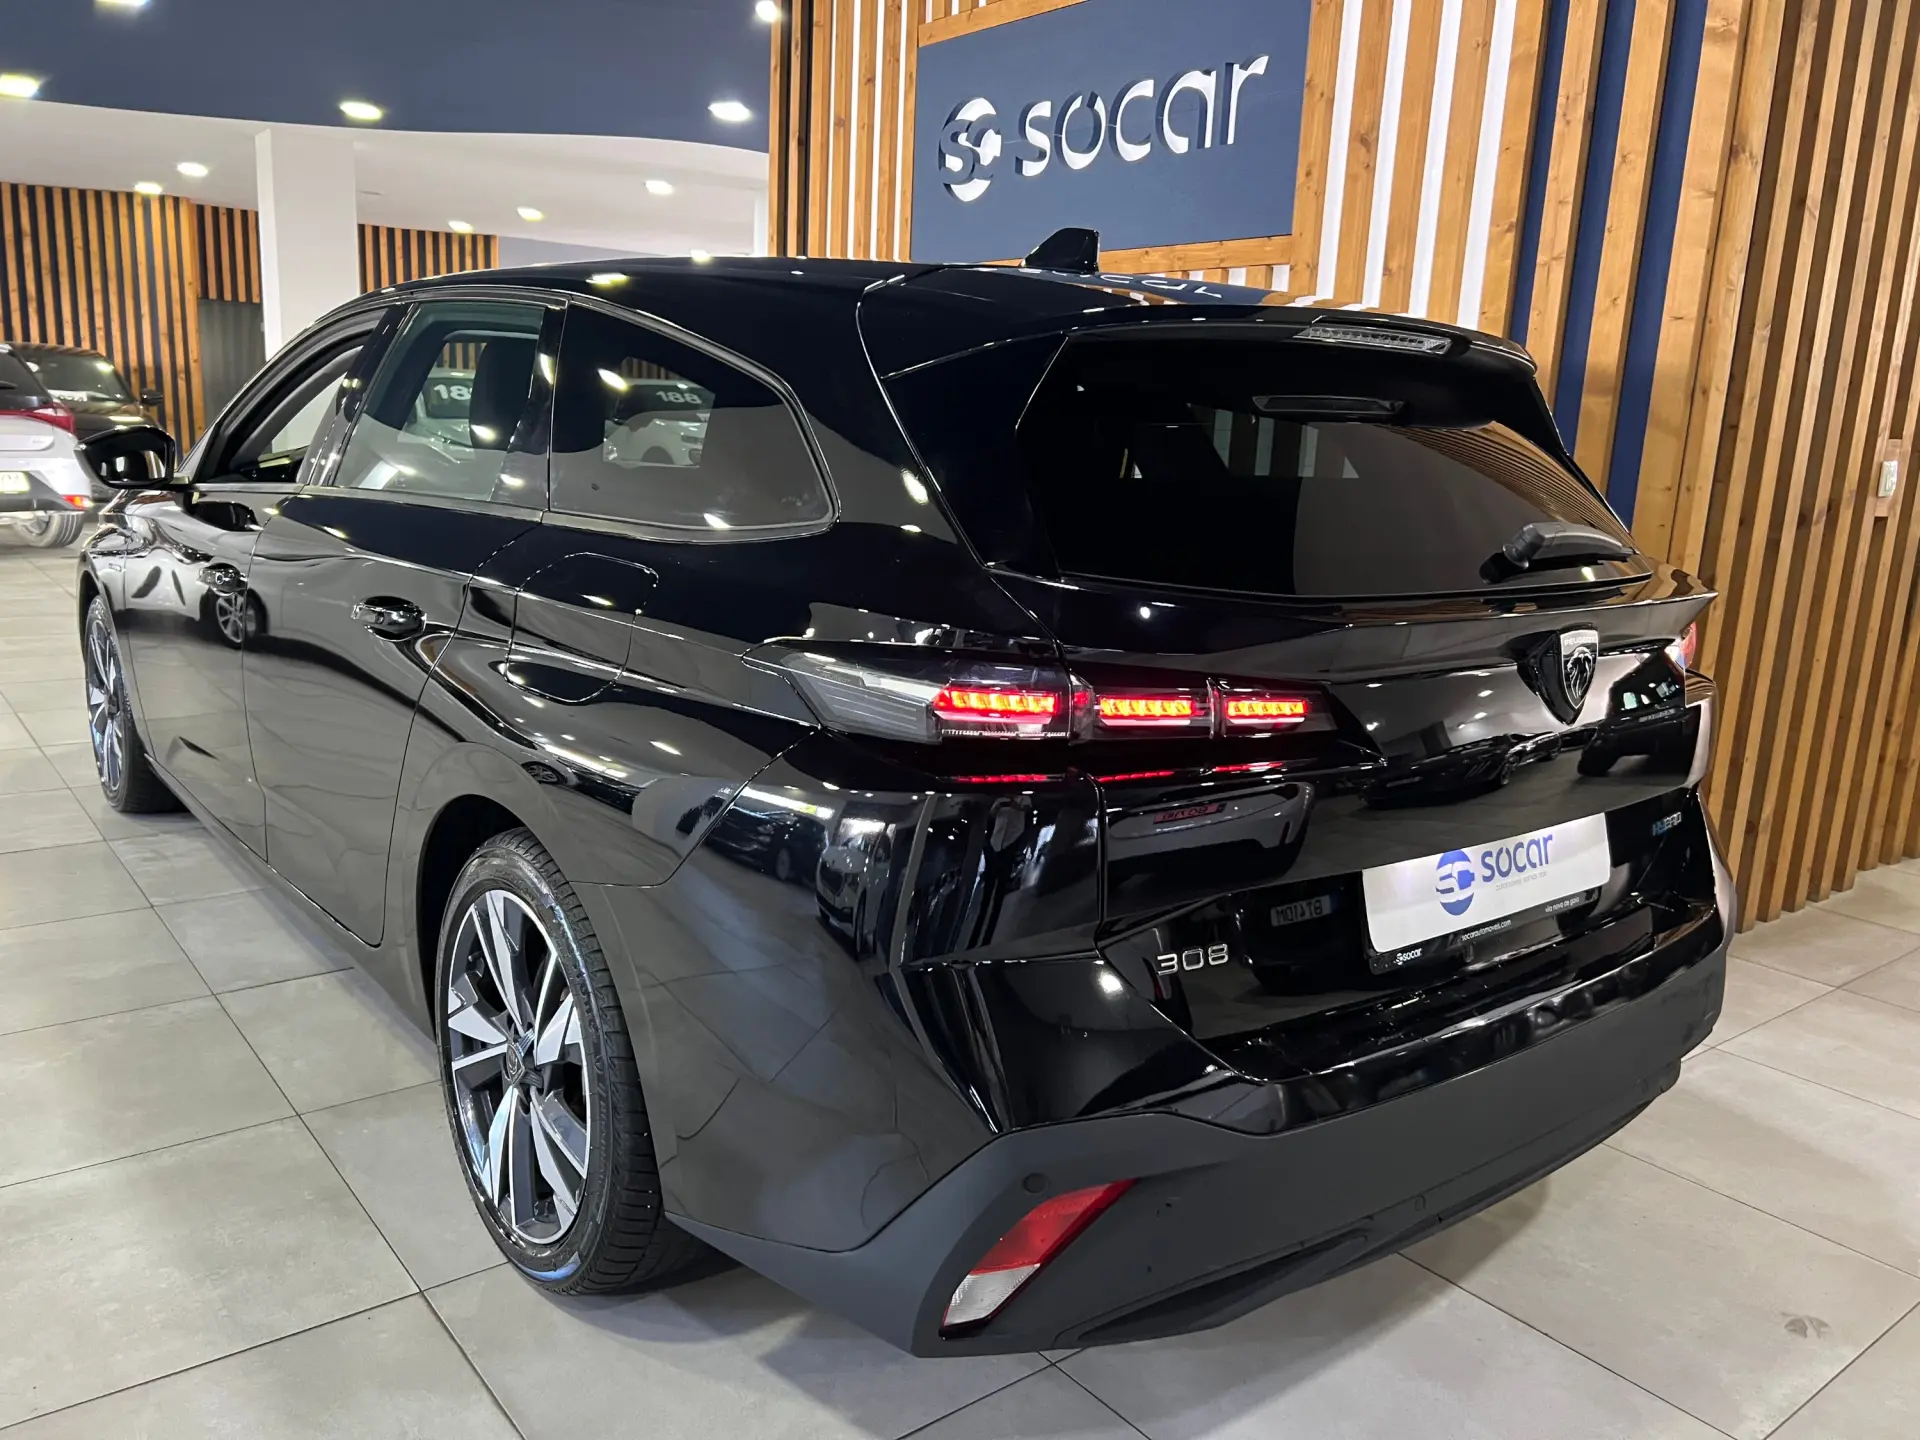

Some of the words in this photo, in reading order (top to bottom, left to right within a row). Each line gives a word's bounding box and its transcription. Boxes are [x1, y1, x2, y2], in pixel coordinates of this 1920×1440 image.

[1015, 55, 1269, 177] socar
[433, 384, 473, 400] 18
[1481, 834, 1553, 882] socar
[1157, 944, 1229, 976] 308
